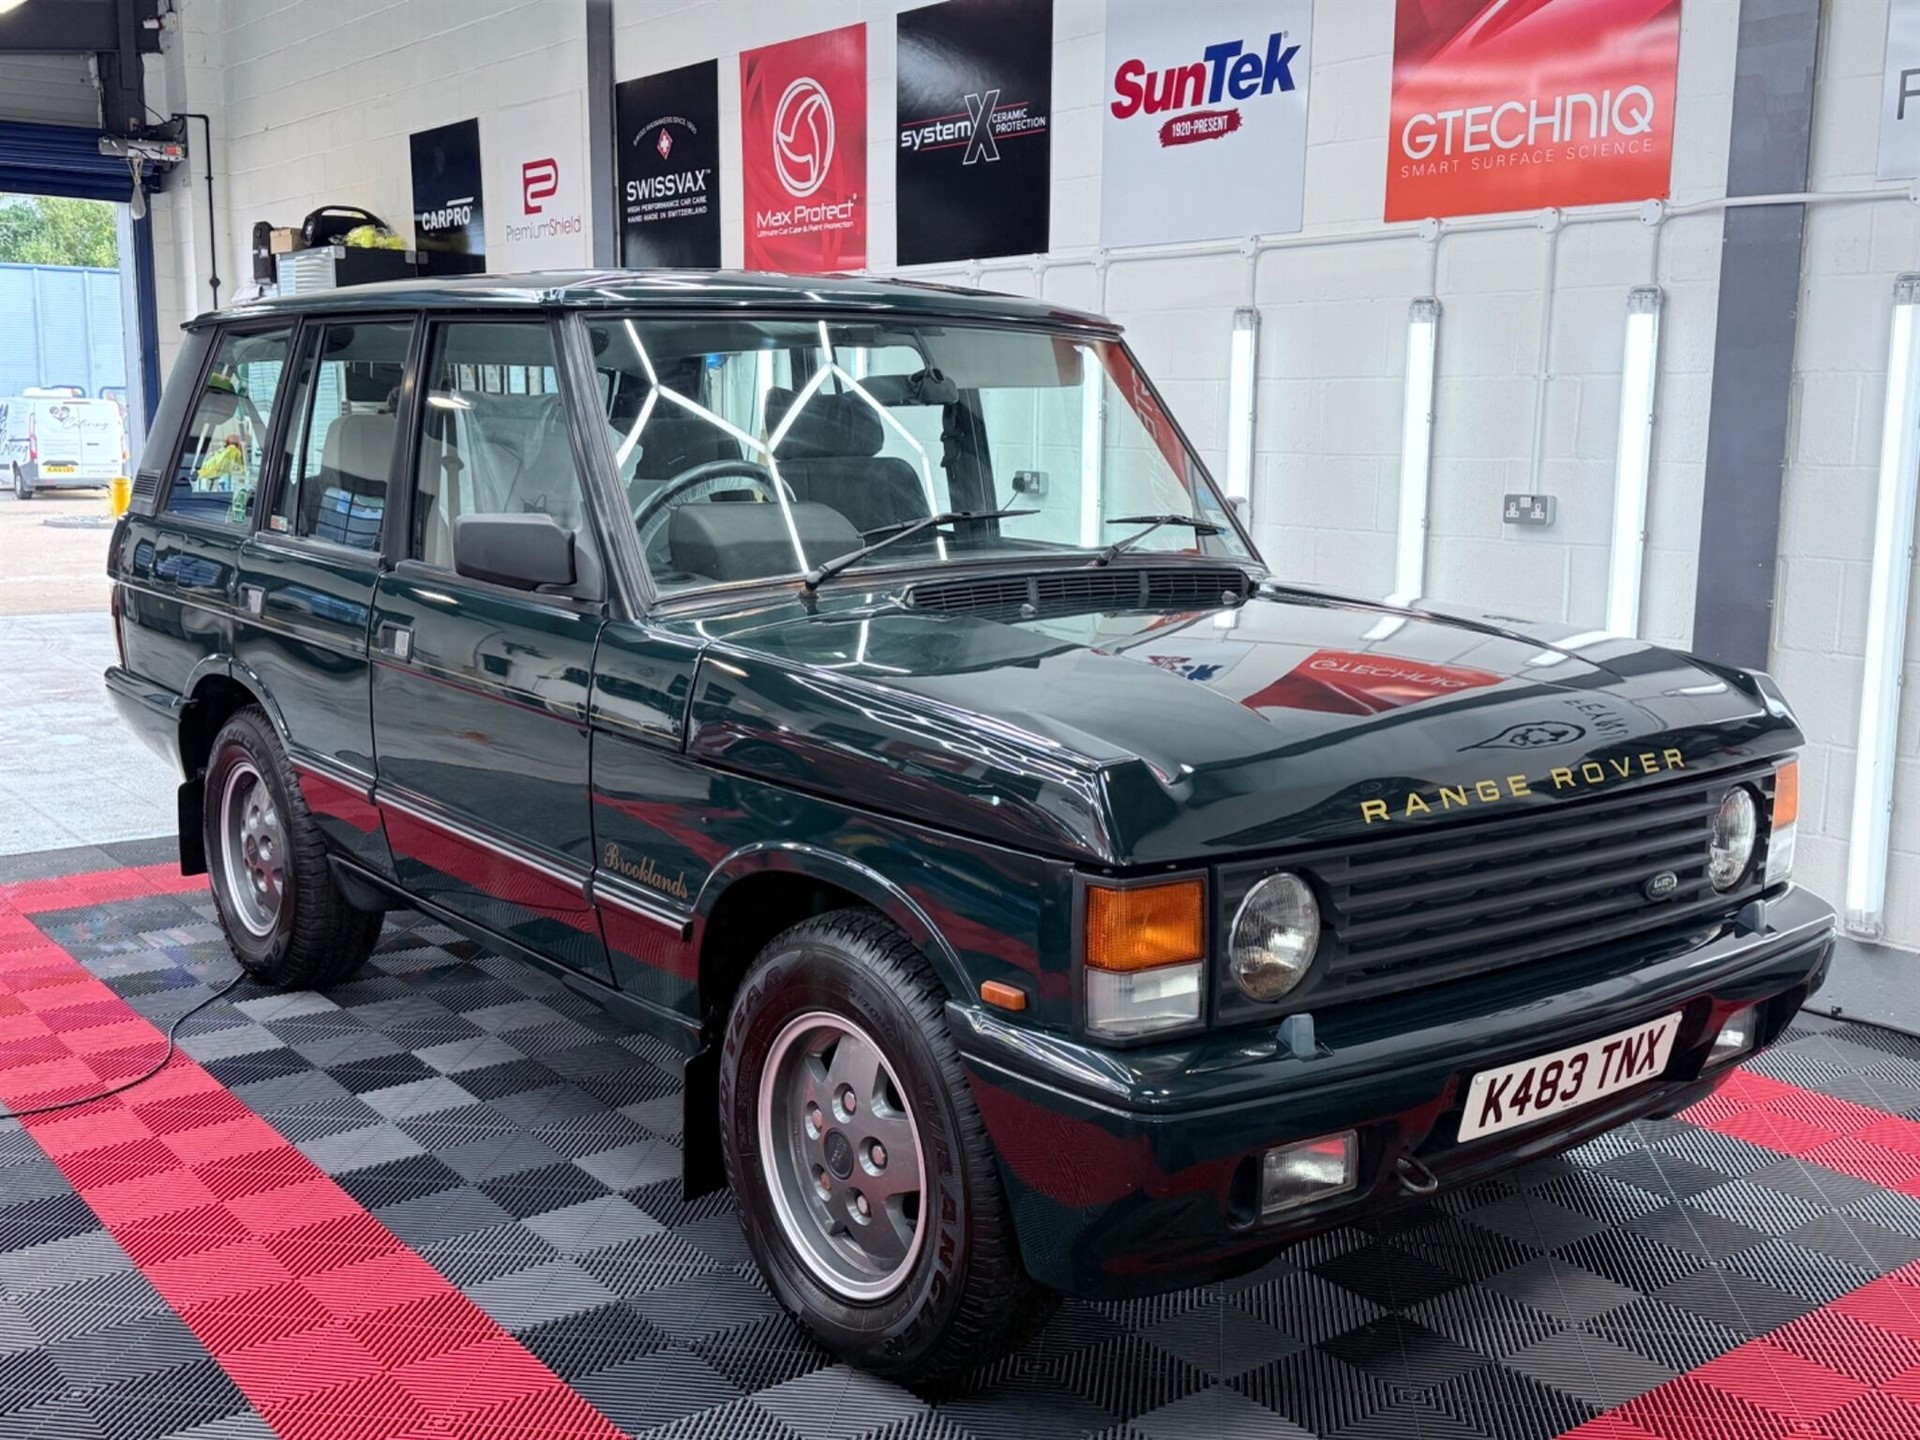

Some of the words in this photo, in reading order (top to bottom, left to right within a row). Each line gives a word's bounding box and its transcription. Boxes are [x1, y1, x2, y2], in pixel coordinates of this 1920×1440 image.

[1111, 32, 1301, 119] SunTek
[991, 108, 1028, 123] CERAMIC
[996, 116, 1046, 134] PROTECTION
[1172, 116, 1228, 137] 1920-PRESENT
[1401, 85, 1655, 160] GTECHNIQ
[1401, 159, 1460, 178] SMART
[1471, 149, 1554, 170] SURFACE
[1566, 138, 1653, 159] SCIENCE
[627, 169, 706, 201] SWISSVAX
[421, 206, 471, 231] CARPRO
[627, 205, 640, 214] HIGH
[641, 199, 679, 211] PERFORMANCE
[680, 198, 691, 207] CAR
[692, 195, 707, 204] CARE
[627, 215, 642, 224] HAND
[643, 212, 658, 222] MADE
[667, 206, 708, 219] SWITZERLAND
[756, 210, 791, 228] Max
[794, 199, 854, 224] Protect
[506, 215, 582, 242] PremiumShield
[823, 221, 854, 230] Protection
[1360, 774, 1532, 825] RANGE
[1551, 748, 1686, 790] ROVER
[604, 842, 688, 900] Brooklands
[1478, 1051, 1589, 1129] K483
[1597, 1023, 1667, 1090] TNX
